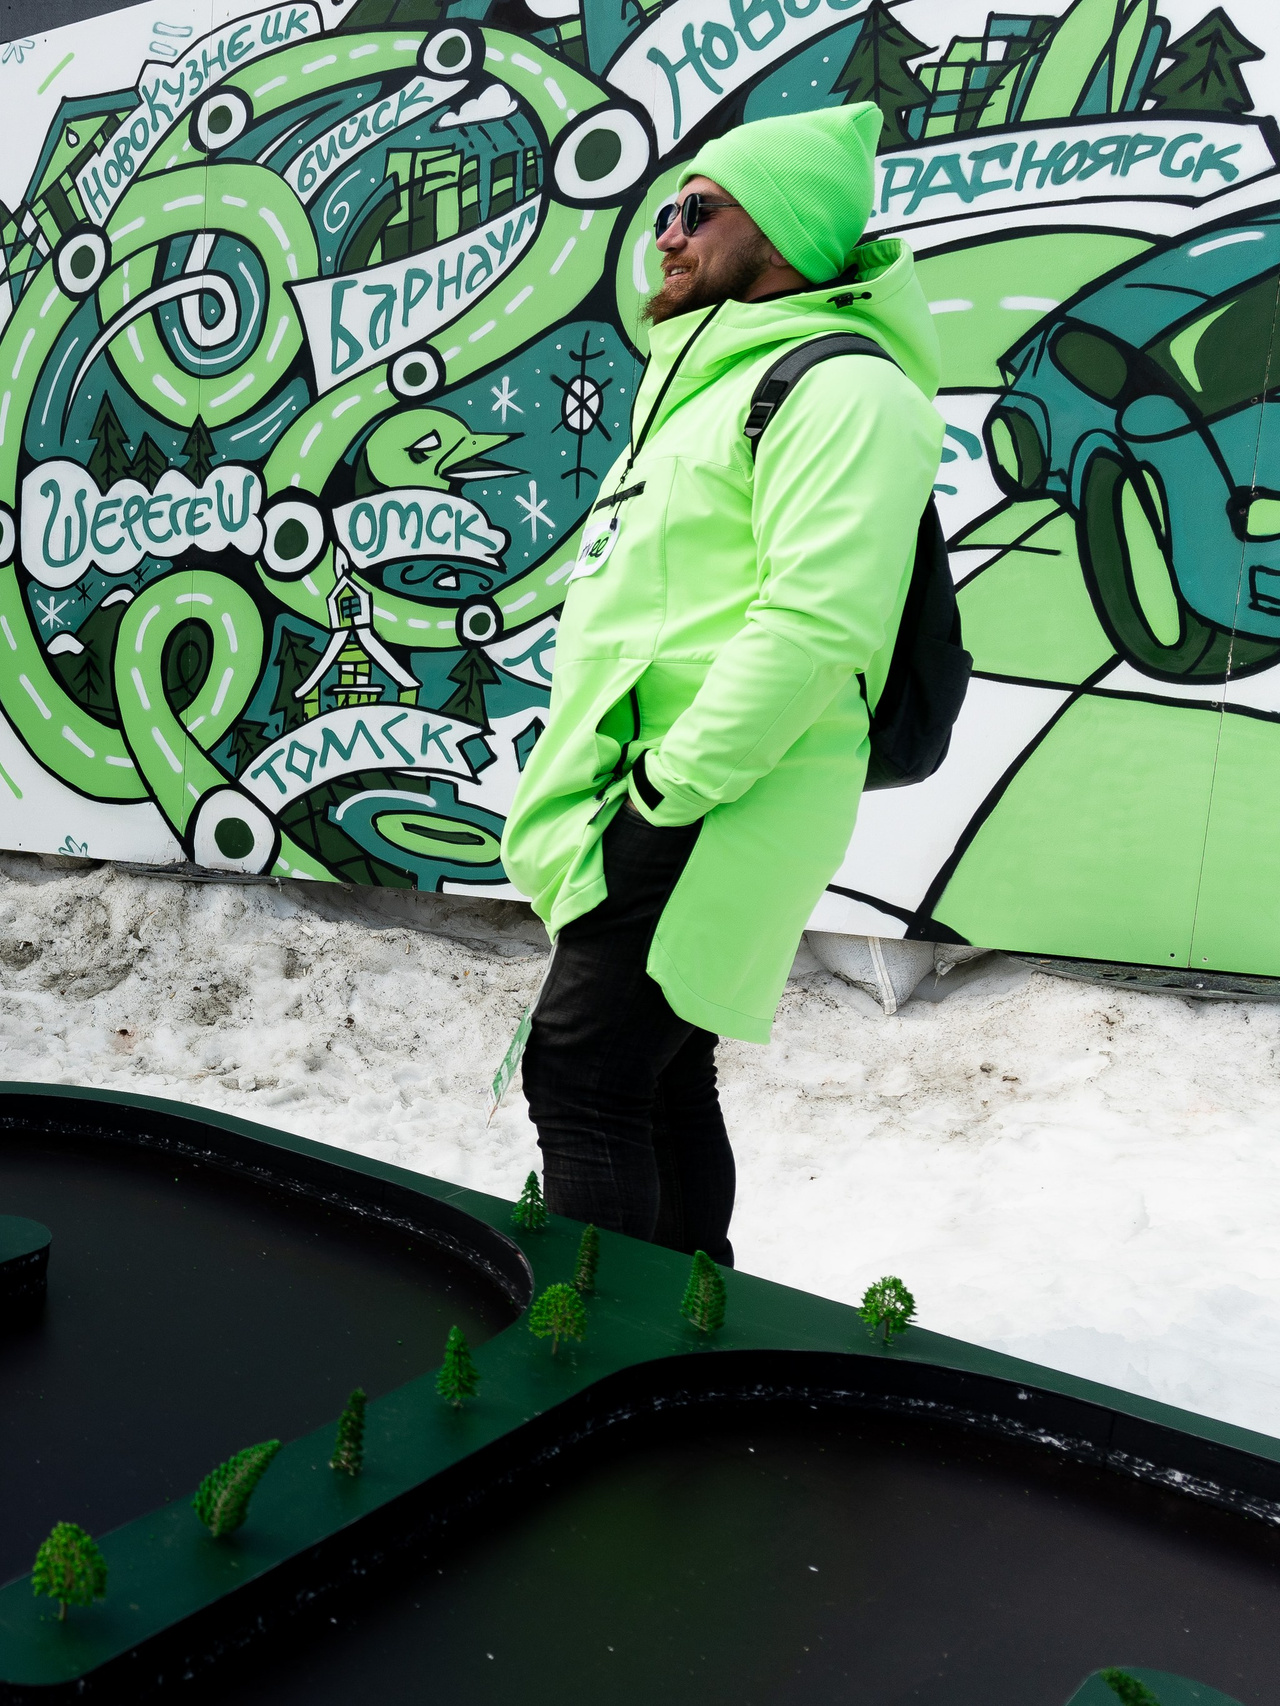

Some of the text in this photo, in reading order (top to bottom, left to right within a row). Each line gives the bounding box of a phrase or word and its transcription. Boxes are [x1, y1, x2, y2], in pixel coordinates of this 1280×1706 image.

[870, 132, 1242, 216] РАСНОЯРСК
[348, 500, 498, 559] ОМСК
[250, 712, 454, 794] ТОМСК
